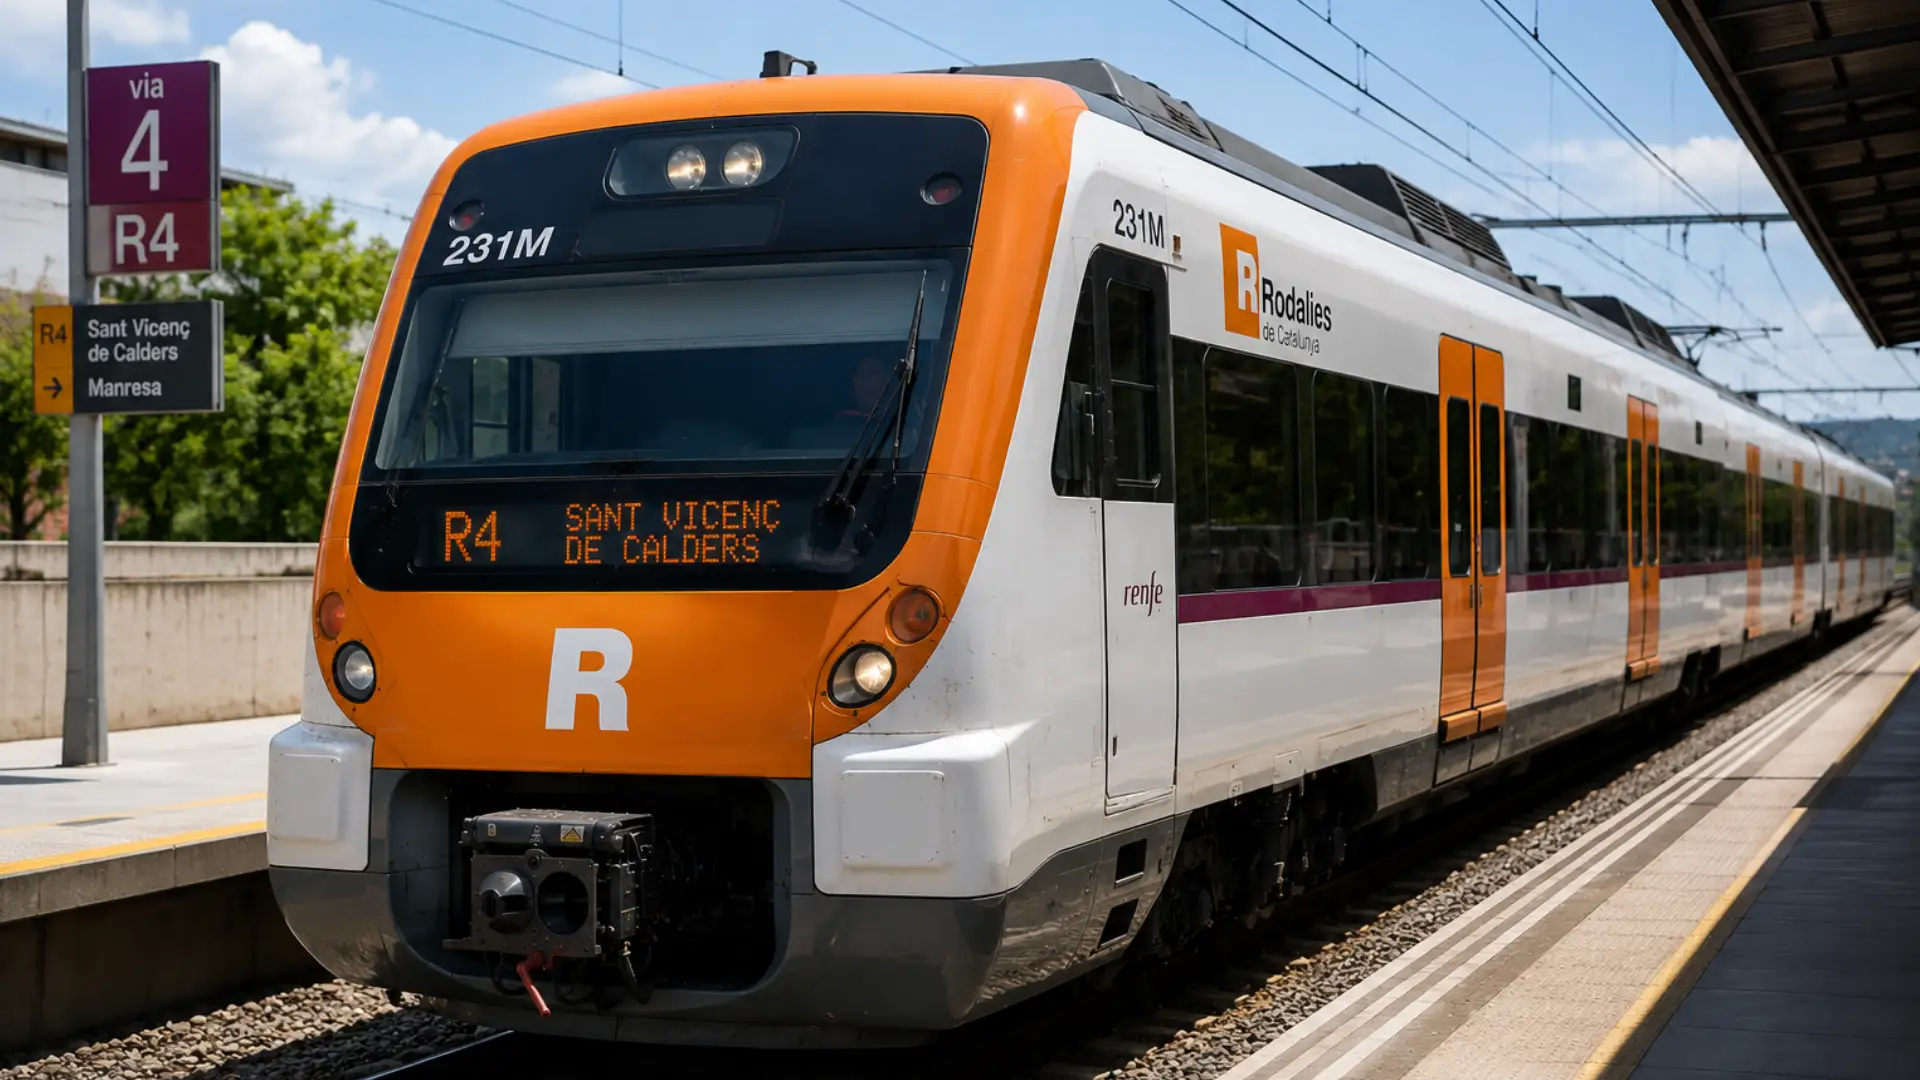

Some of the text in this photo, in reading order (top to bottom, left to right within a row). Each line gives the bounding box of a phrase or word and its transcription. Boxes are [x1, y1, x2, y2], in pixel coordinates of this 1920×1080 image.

[130, 72, 164, 99] via
[121, 109, 168, 191] 4
[115, 212, 179, 264] R4
[1112, 199, 1165, 249] 231M
[443, 226, 555, 266] 231M
[1236, 249, 1259, 313] R
[1262, 277, 1332, 332] Rodalies
[40, 323, 68, 345] R4
[88, 319, 191, 340] Sant Vicenç
[1262, 321, 1320, 356] de Catalunya
[88, 341, 178, 362] de Calders
[88, 377, 162, 397] Manresa
[445, 511, 501, 562] R4
[566, 500, 780, 533] SANT VICENÇ
[565, 533, 760, 564] DE CALDERS
[1124, 570, 1163, 617] renfe
[545, 628, 633, 731] R
